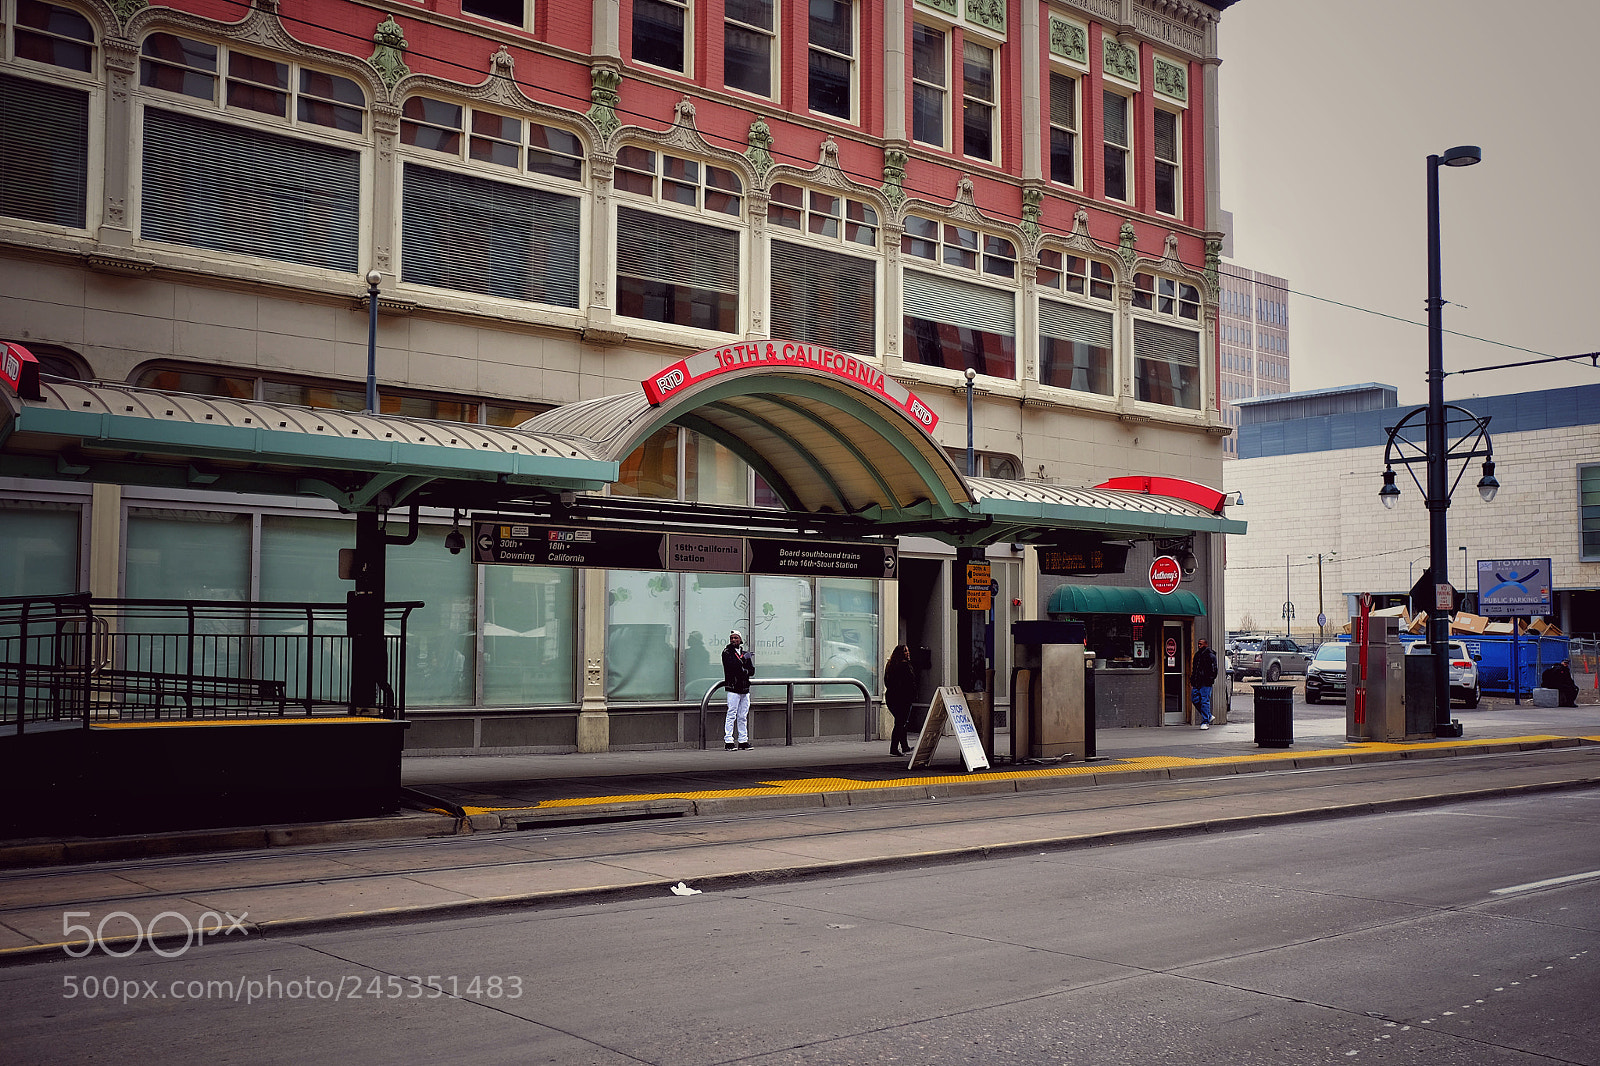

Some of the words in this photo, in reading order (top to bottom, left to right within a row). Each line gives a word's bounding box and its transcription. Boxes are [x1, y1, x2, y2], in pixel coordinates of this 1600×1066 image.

[6, 353, 20, 381] RTD
[715, 343, 760, 368] 16TH
[766, 342, 777, 362] &
[783, 343, 885, 391] CALIFORNIA
[656, 369, 684, 395] RTD
[910, 399, 933, 425] RTD
[500, 550, 535, 562] Downing
[548, 552, 584, 562] California
[674, 553, 705, 562] Station
[780, 548, 800, 557] Board
[801, 550, 841, 559] southbound
[842, 551, 860, 560] trains
[787, 559, 799, 567] the
[836, 561, 858, 569] Station
[1151, 569, 1178, 582] Anthony's
[1509, 596, 1539, 604] PARKING
[1131, 614, 1146, 623] OPEN
[950, 704, 963, 713] STOP
[953, 714, 967, 723] LOOK
[956, 723, 975, 733] LISTEN
